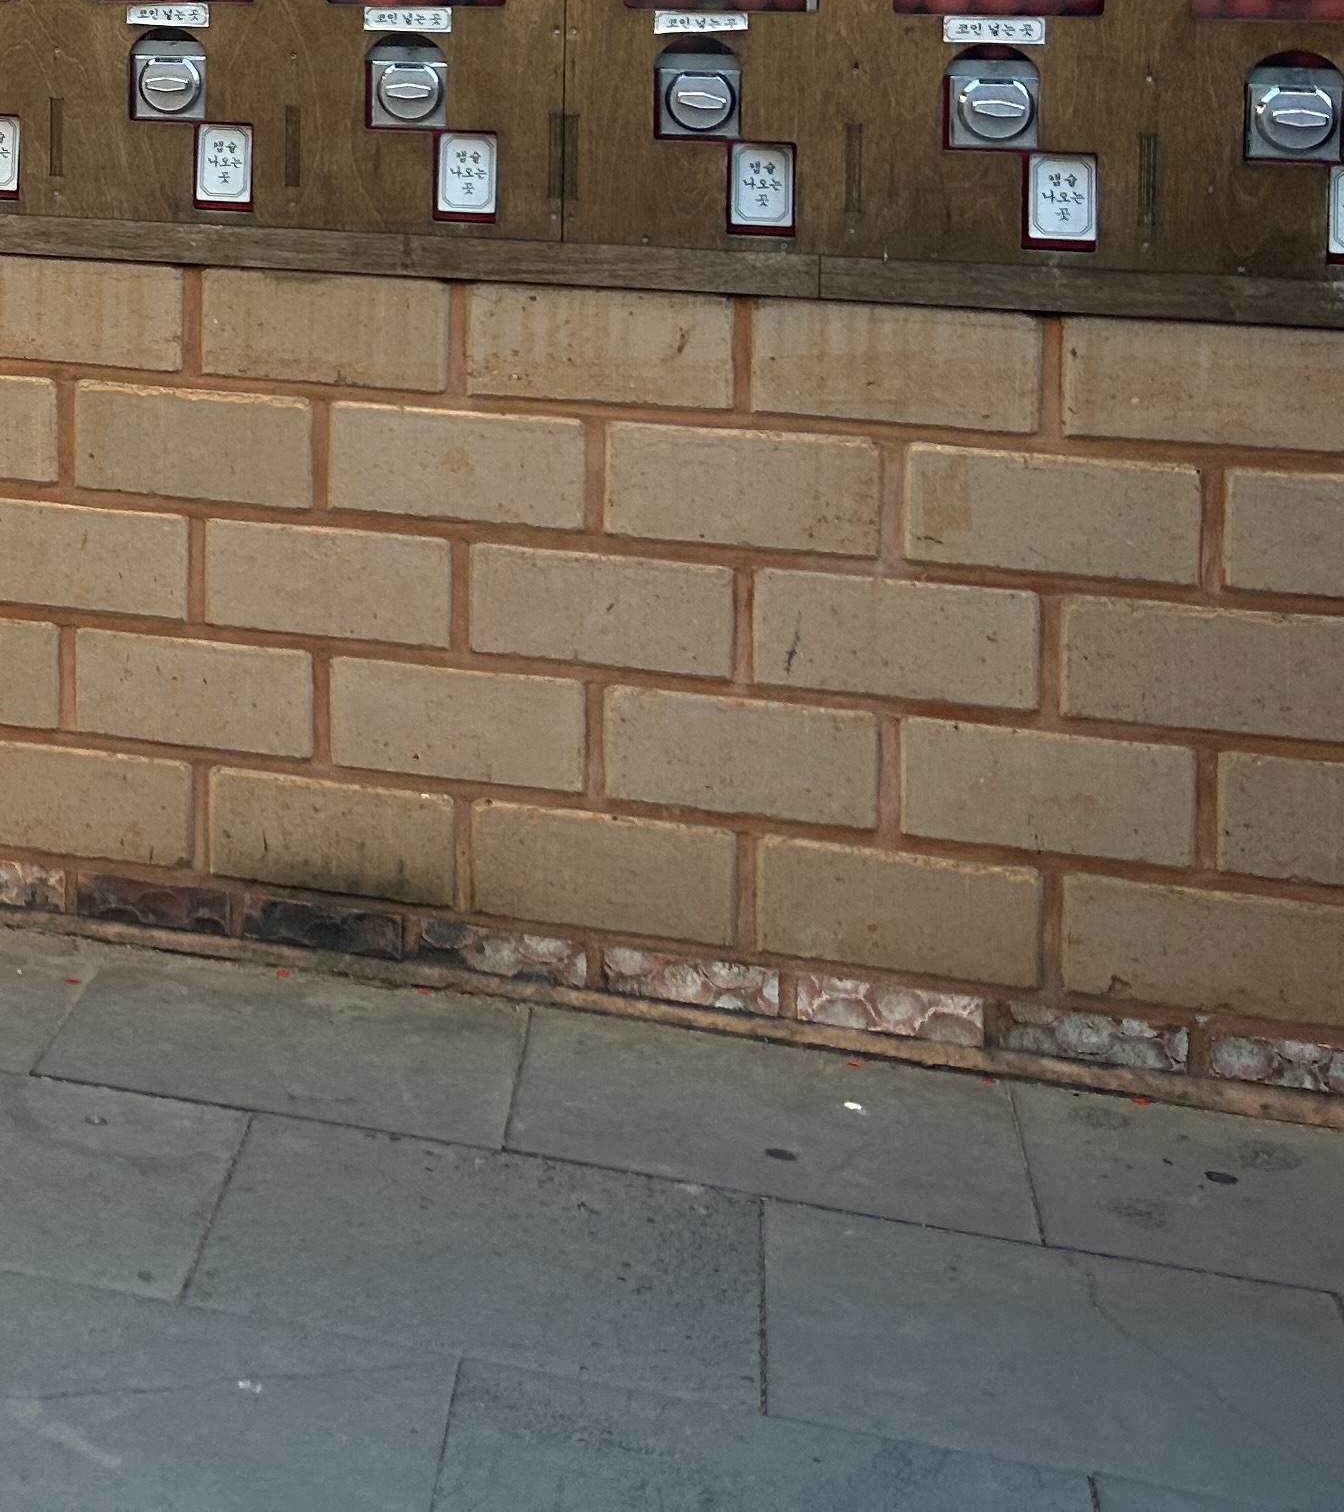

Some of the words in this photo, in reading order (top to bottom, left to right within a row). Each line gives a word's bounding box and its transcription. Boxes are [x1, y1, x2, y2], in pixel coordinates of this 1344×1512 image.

[137, 8, 159, 21] 코인
[163, 8, 186, 21] 넣는
[188, 9, 200, 22] 곳
[375, 12, 399, 24] 코인
[402, 12, 427, 26] 넣는
[429, 13, 442, 27] 곳
[666, 17, 690, 29] 코인
[695, 17, 722, 29] 넣는
[725, 18, 738, 29] 곳
[955, 23, 982, 36] 코인
[988, 23, 1016, 37] 넣는
[1020, 23, 1034, 37] 곳
[214, 140, 238, 154] 캡슐
[207, 155, 243, 169] 나오는
[456, 150, 482, 164] 캡슐
[450, 165, 488, 180] 나오는
[749, 161, 776, 175] 캡슐
[218, 171, 231, 184] 곳
[743, 176, 782, 191] 나오는
[1048, 173, 1078, 188] 캡슐
[461, 182, 475, 196] 곳
[755, 193, 769, 207] 곳
[1041, 189, 1085, 205] 나오는
[1055, 207, 1071, 221] 곳
